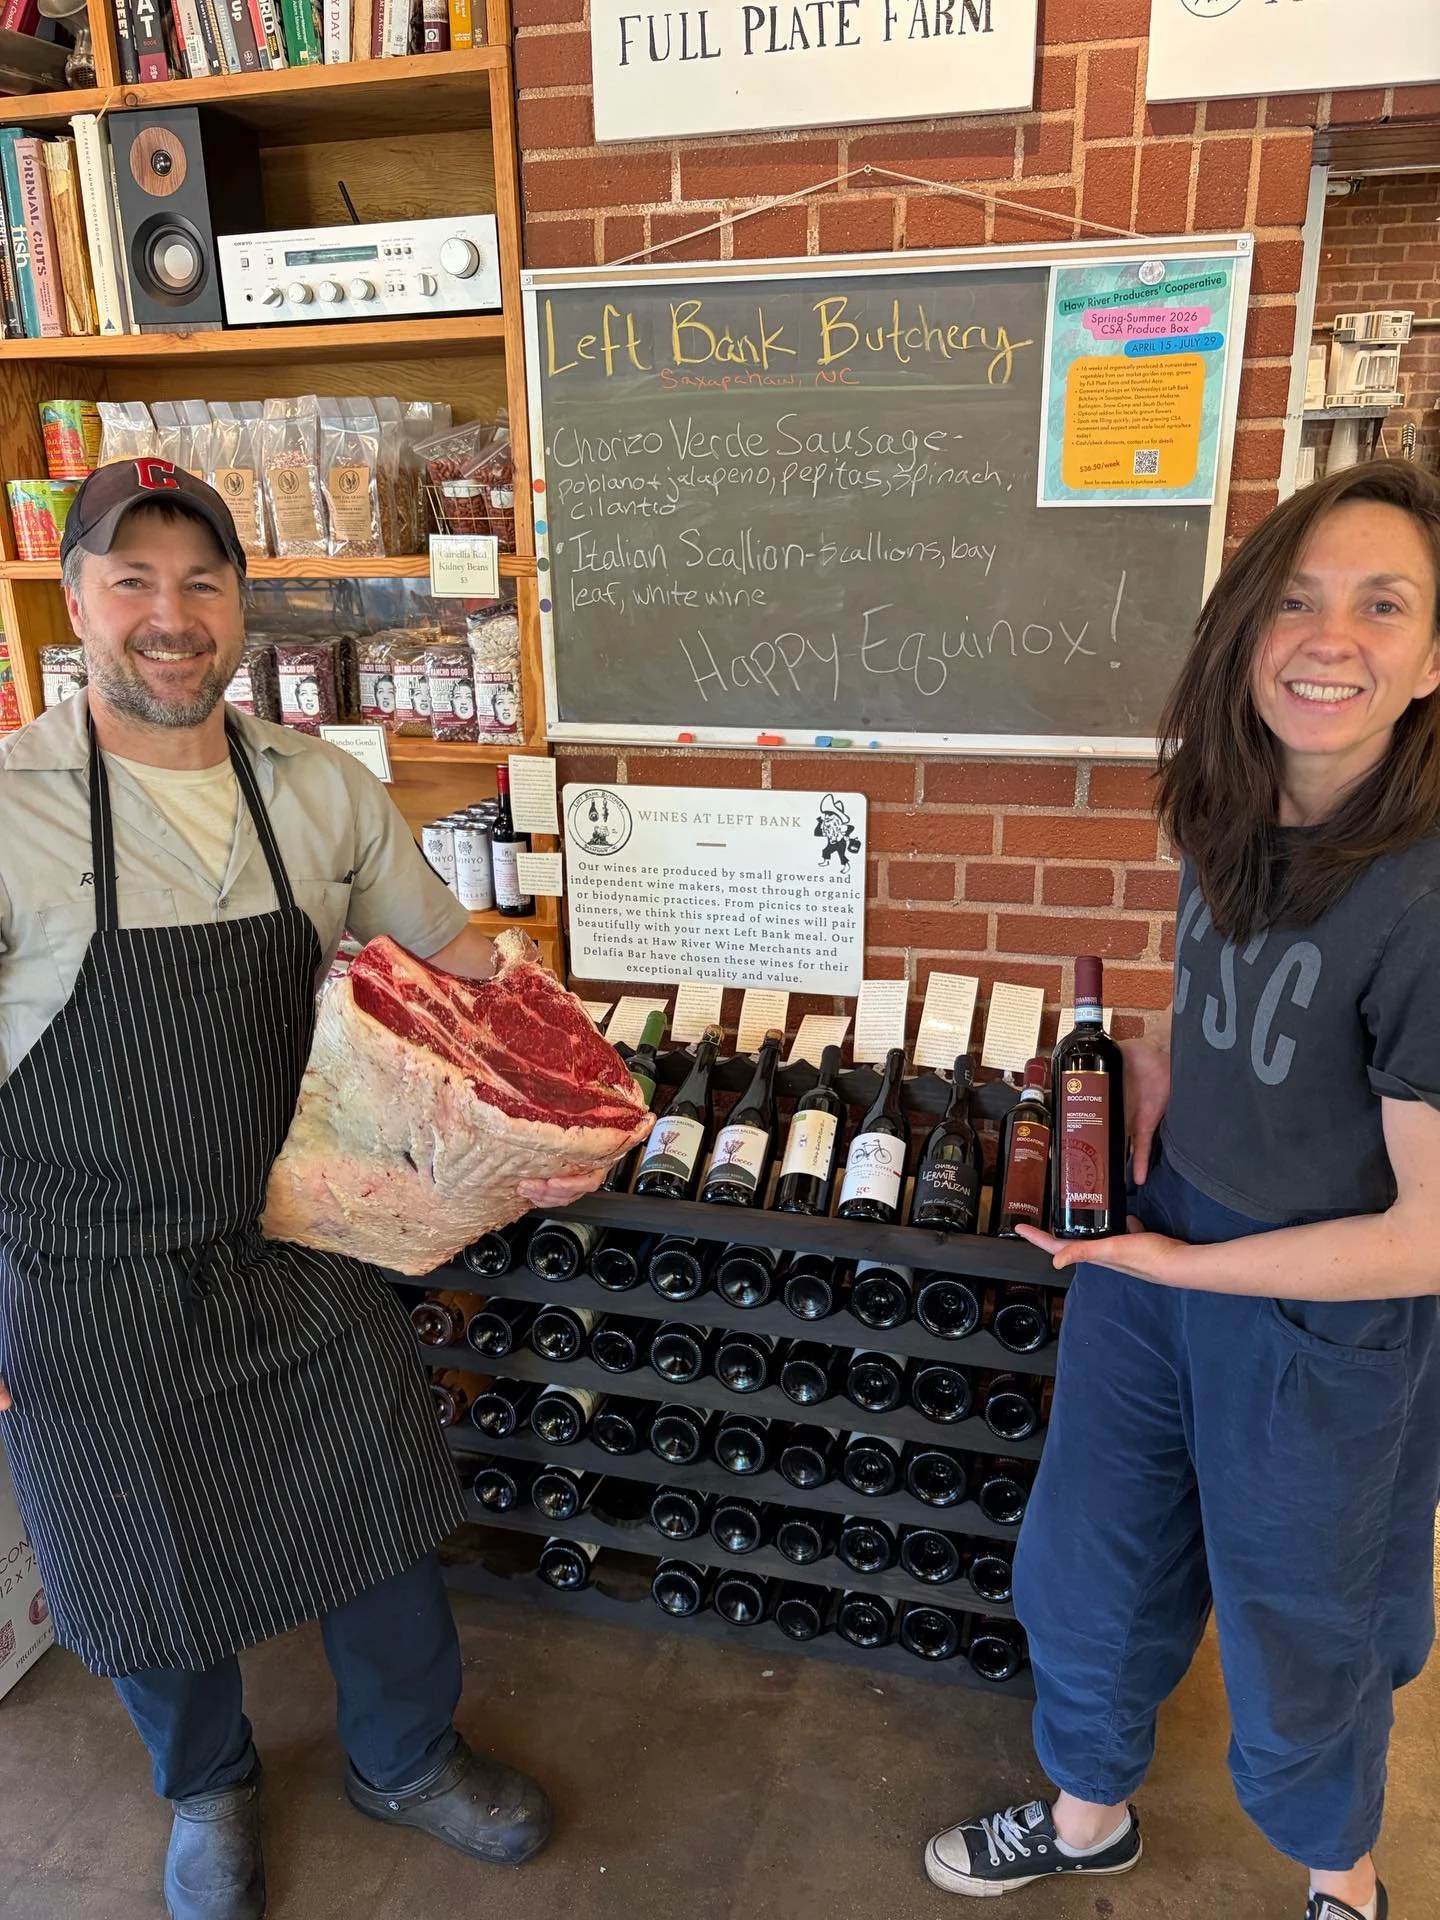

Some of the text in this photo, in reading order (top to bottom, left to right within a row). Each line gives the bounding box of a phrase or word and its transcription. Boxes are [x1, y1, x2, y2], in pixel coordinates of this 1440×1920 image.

[116, 0, 129, 39] BEEF
[331, 14, 341, 40] DAY
[618, 0, 994, 66] FULL PLATE FARM
[83, 138, 91, 166] FRENCH
[87, 168, 96, 201] LAUNDRY
[22, 154, 39, 225] PRIMAL
[33, 230, 47, 277] CUTS
[91, 203, 100, 247] COOKBOOK
[11, 224, 29, 270] fish
[1064, 276, 1222, 311] Haw River Producers' Cooperative
[1091, 312, 1198, 325] Spring-Summer 2026
[1101, 323, 1189, 335] CSA Produce Box
[545, 296, 1034, 385] Left Bank Butchery
[1132, 336, 1216, 353] APRIL 15 JULY 29
[815, 367, 860, 387] NC
[553, 426, 664, 468] Chorizo
[669, 416, 769, 461] Verde
[134, 456, 180, 490] C
[780, 458, 892, 498] pepitas,
[1080, 460, 1120, 473] $36.50/week
[473, 549, 487, 559] Red
[569, 530, 668, 572] Italian
[951, 536, 997, 576] bay
[439, 562, 489, 573] Kidney Beans
[570, 577, 767, 615] leaf, white wine
[450, 668, 469, 676] GORDO
[679, 625, 840, 701] Happy
[493, 673, 512, 681] GORDO
[355, 738, 377, 746] Gordo
[638, 810, 801, 828] WINES AT LEFT BANK
[578, 861, 599, 872] Our
[604, 863, 637, 874] wines
[663, 867, 717, 878] produced
[721, 868, 736, 881] by
[739, 870, 772, 880] small
[776, 873, 824, 883] growers
[829, 874, 851, 884] and
[570, 875, 861, 900] independent wine makers, most through organic
[592, 891, 660, 903] biodynamic
[663, 896, 720, 907] practices.
[725, 898, 754, 908] From
[758, 900, 801, 911] picnics
[806, 904, 817, 912] to
[822, 904, 854, 914] steak
[575, 904, 857, 930] dinners, we think this spread of wines will pair
[577, 918, 854, 943] beautifully with your next Left Bank meal. Our
[593, 933, 838, 957] friends at Haw River Wine Merchants and
[583, 946, 849, 972] Delafia Bar have chosen these wines for their
[626, 964, 803, 983] exceptional quality and value.
